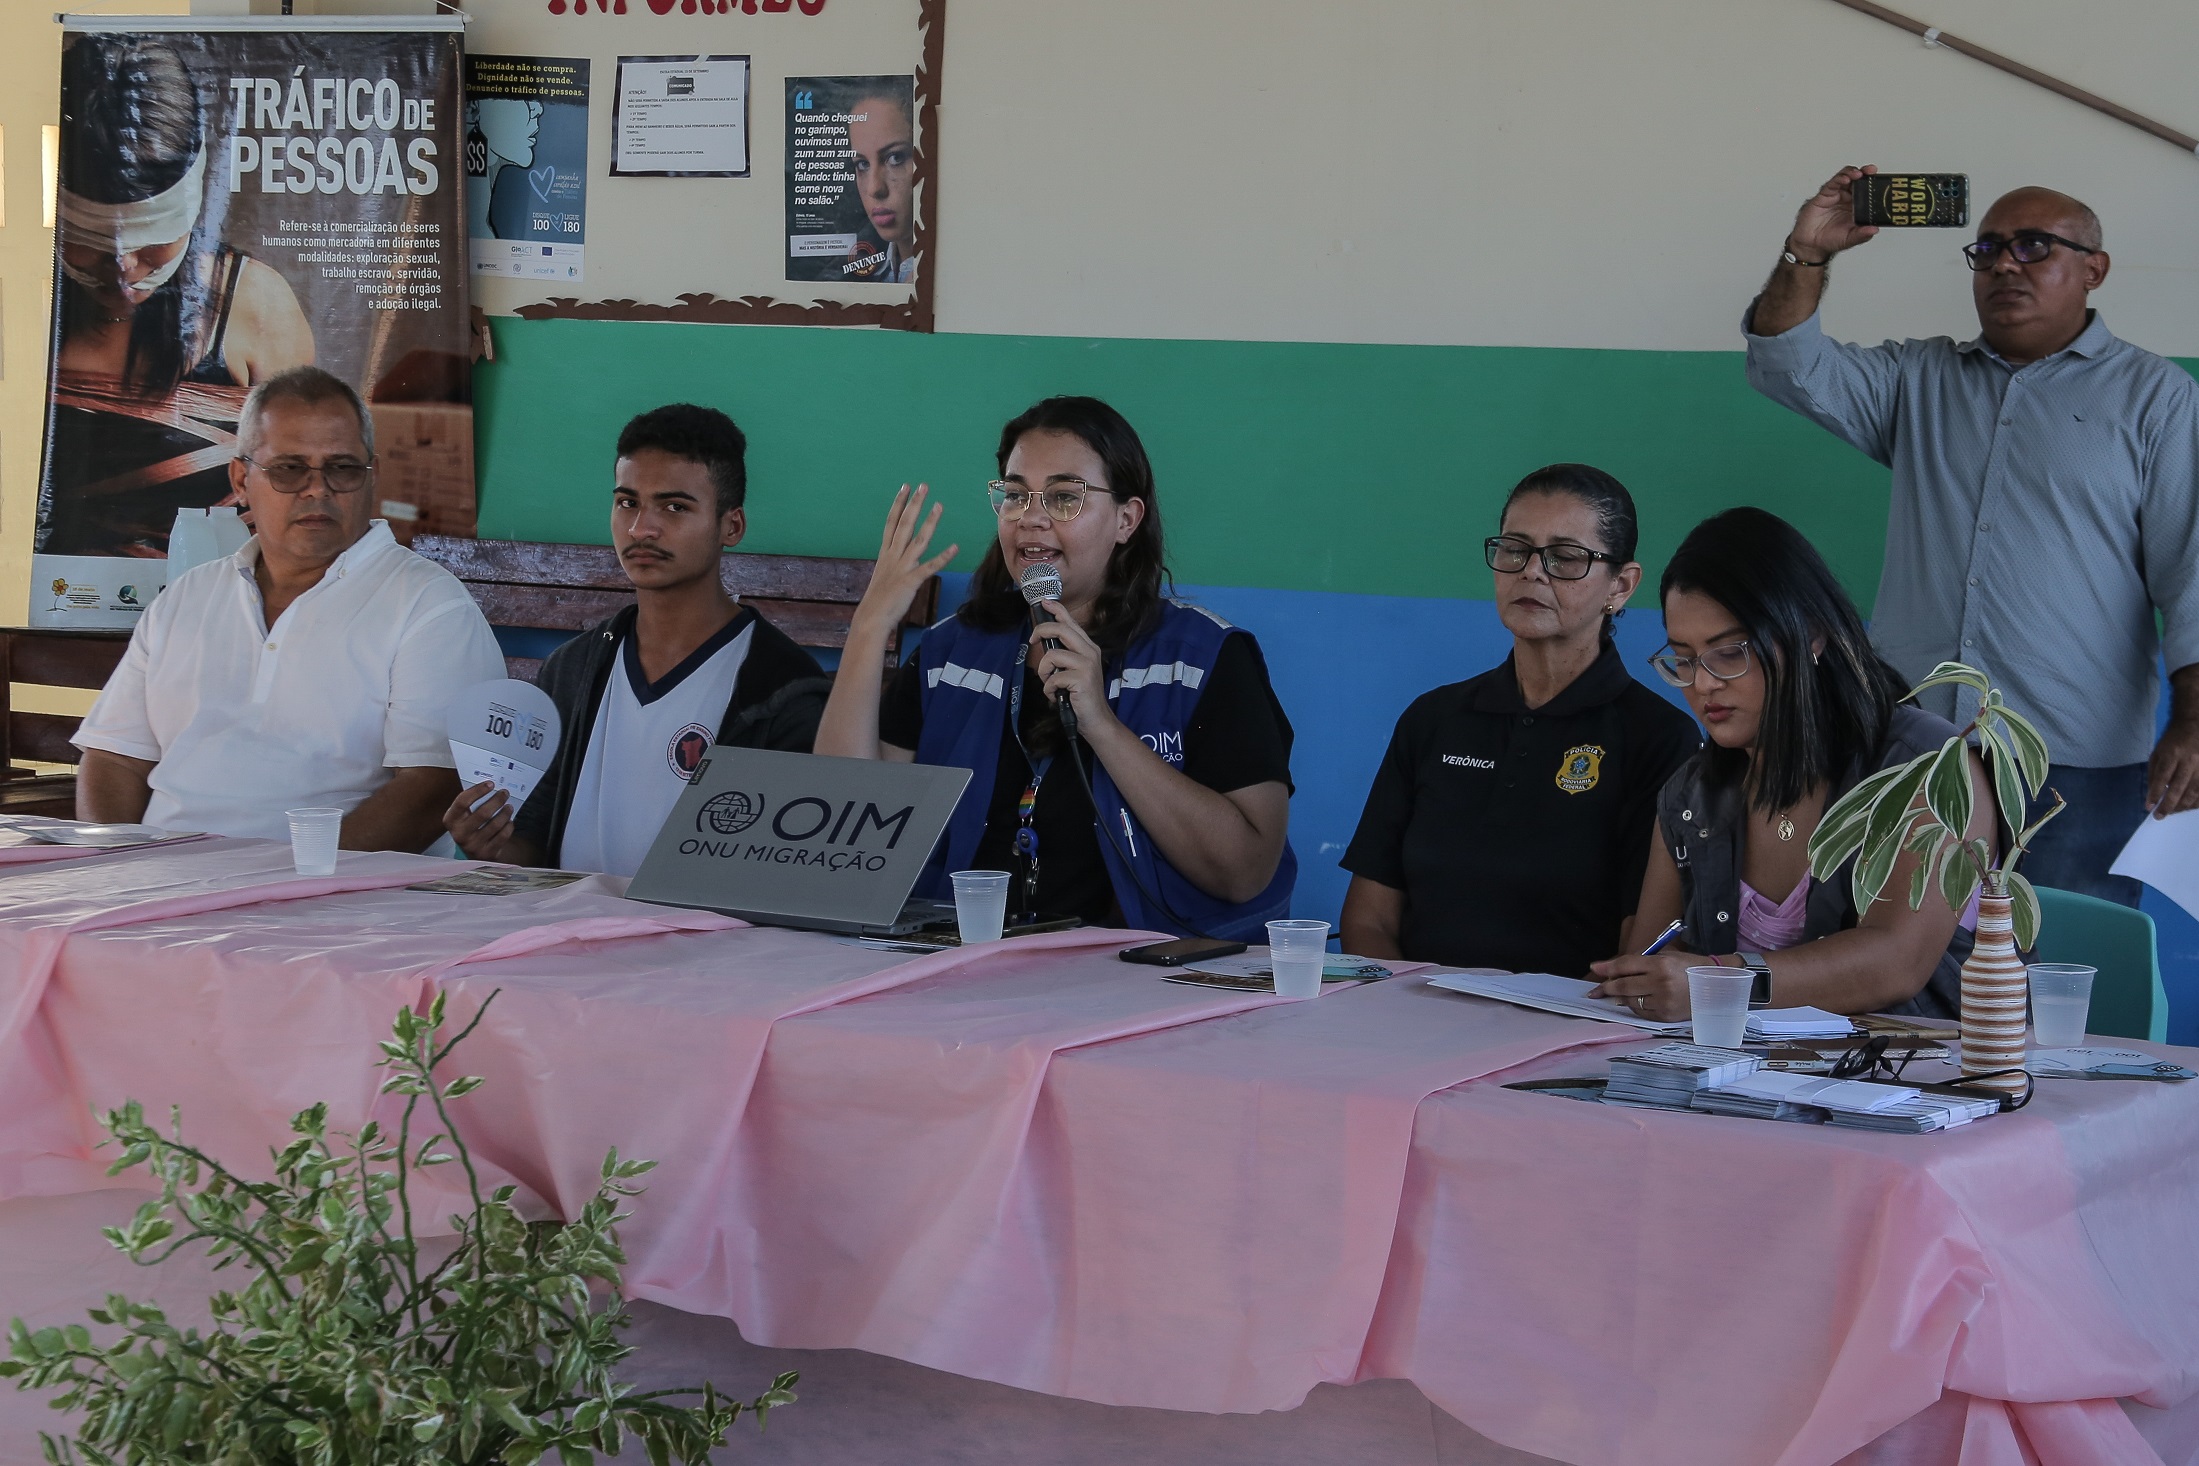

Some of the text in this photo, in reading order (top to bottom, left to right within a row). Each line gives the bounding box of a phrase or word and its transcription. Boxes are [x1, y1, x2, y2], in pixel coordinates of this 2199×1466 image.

[475, 62, 514, 70] Liberdade
[544, 66, 576, 74] compra.
[478, 72, 518, 82] Dignidade
[546, 76, 573, 84] vende.
[466, 84, 502, 92] Denuncie
[512, 86, 536, 94] tráfico
[230, 65, 436, 131] TRÁFICO DE
[795, 112, 868, 124] Quando cheguei
[808, 125, 847, 136] garimpo,
[795, 137, 832, 146] ouvimos
[230, 136, 439, 196] PESSOAS
[795, 160, 844, 171] de pessoas
[795, 172, 855, 181] falando: tinha
[1892, 178, 1908, 225] HARD
[1911, 178, 1926, 224] WORK
[280, 220, 440, 235] Refere-se à comercialização de seres
[532, 220, 580, 233] 100 180
[262, 235, 440, 248] humanos como mercadoria em diferentes
[298, 251, 440, 265] modalidades: exploração sexual,
[842, 252, 886, 274] DENUNCIE
[322, 267, 441, 280] trabalho escravo, servidão,
[356, 283, 442, 296] remoção de órgãos
[368, 298, 442, 312] e adoção ilegal.
[1010, 685, 1019, 705] OIM
[486, 715, 512, 738] 100
[525, 728, 544, 750] 180
[1442, 754, 1495, 769] VERÔNICA
[692, 760, 708, 783] Lenovo
[772, 797, 914, 849] OIM
[679, 839, 886, 872] ONU MIGRAÇÃO
